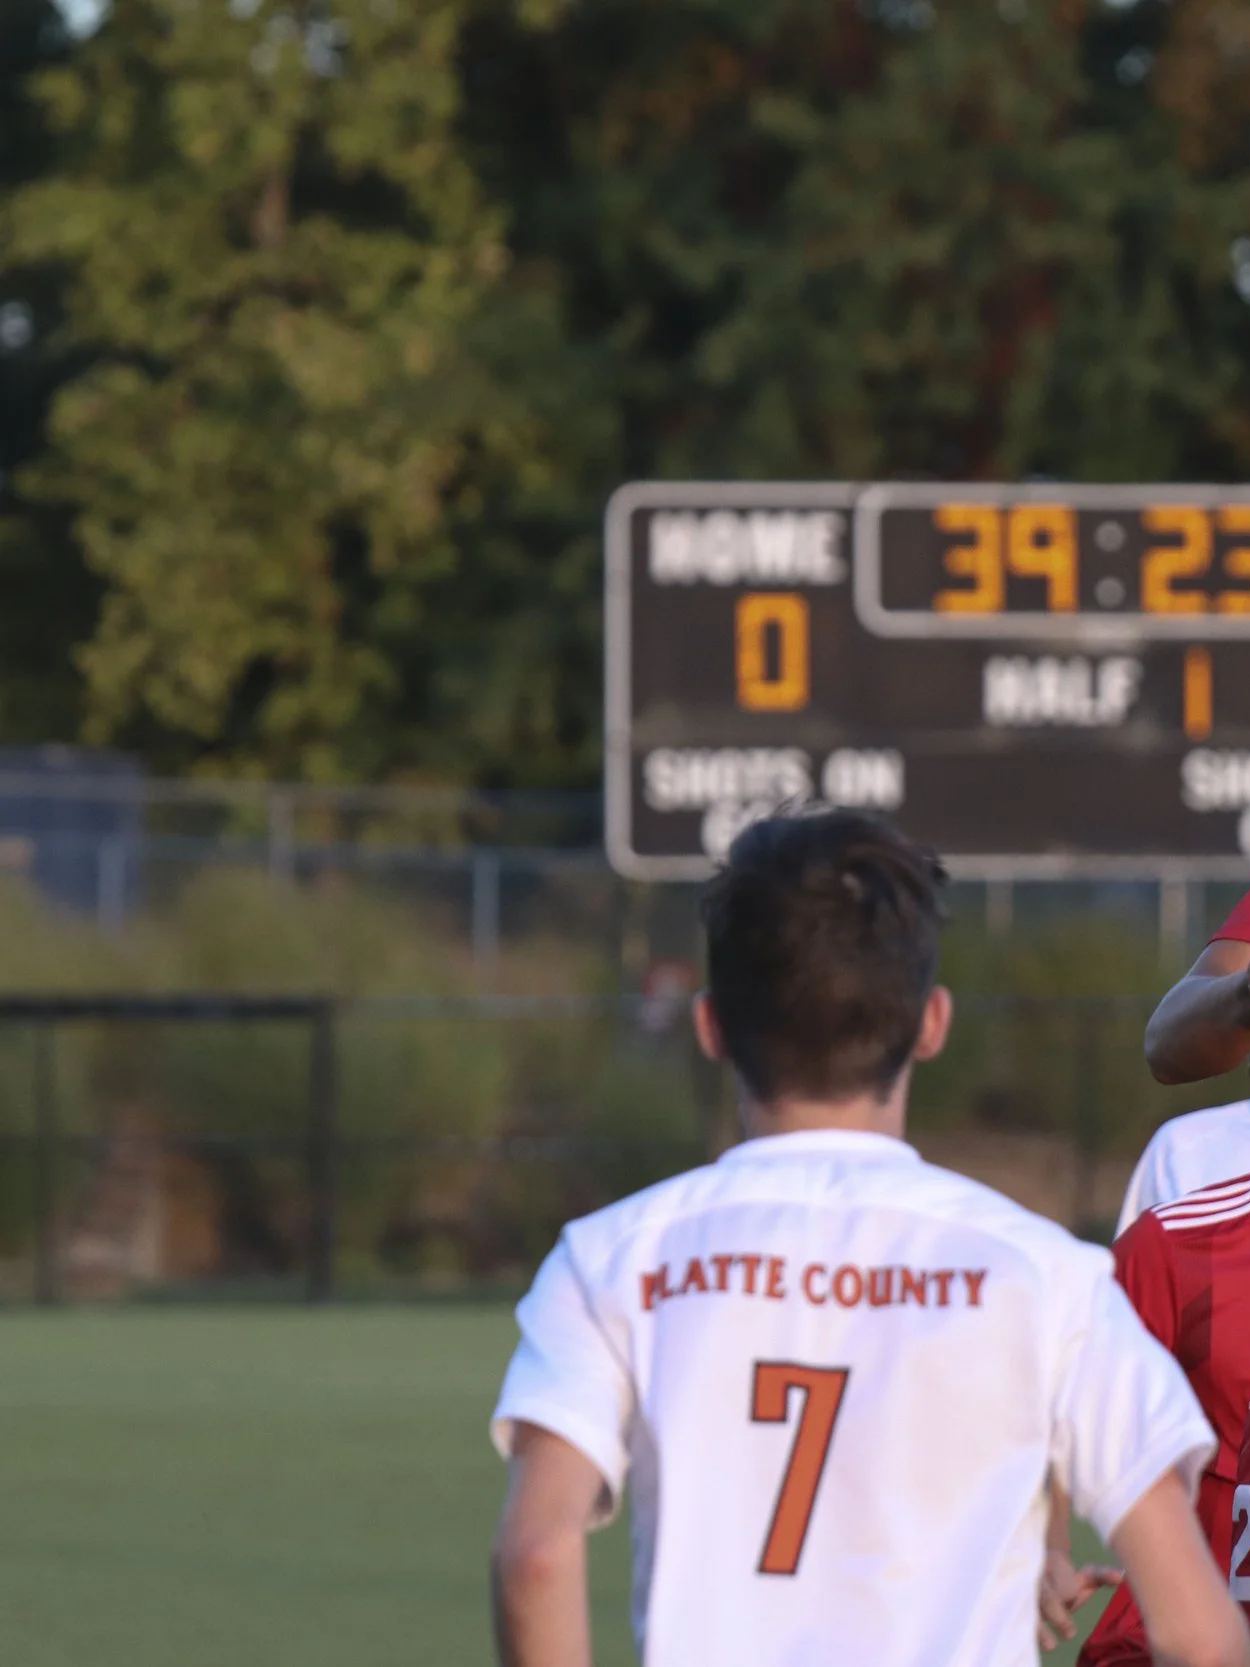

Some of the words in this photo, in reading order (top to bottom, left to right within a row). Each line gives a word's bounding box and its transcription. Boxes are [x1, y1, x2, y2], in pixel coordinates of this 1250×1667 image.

[648, 511, 846, 585] HOME
[736, 592, 810, 711] 0
[982, 656, 1142, 727] HALF
[1184, 647, 1213, 739] 1
[643, 747, 815, 812] SHOTS
[821, 747, 904, 811] ON
[801, 1264, 989, 1308] COUNTY
[750, 1360, 850, 1575] 7
